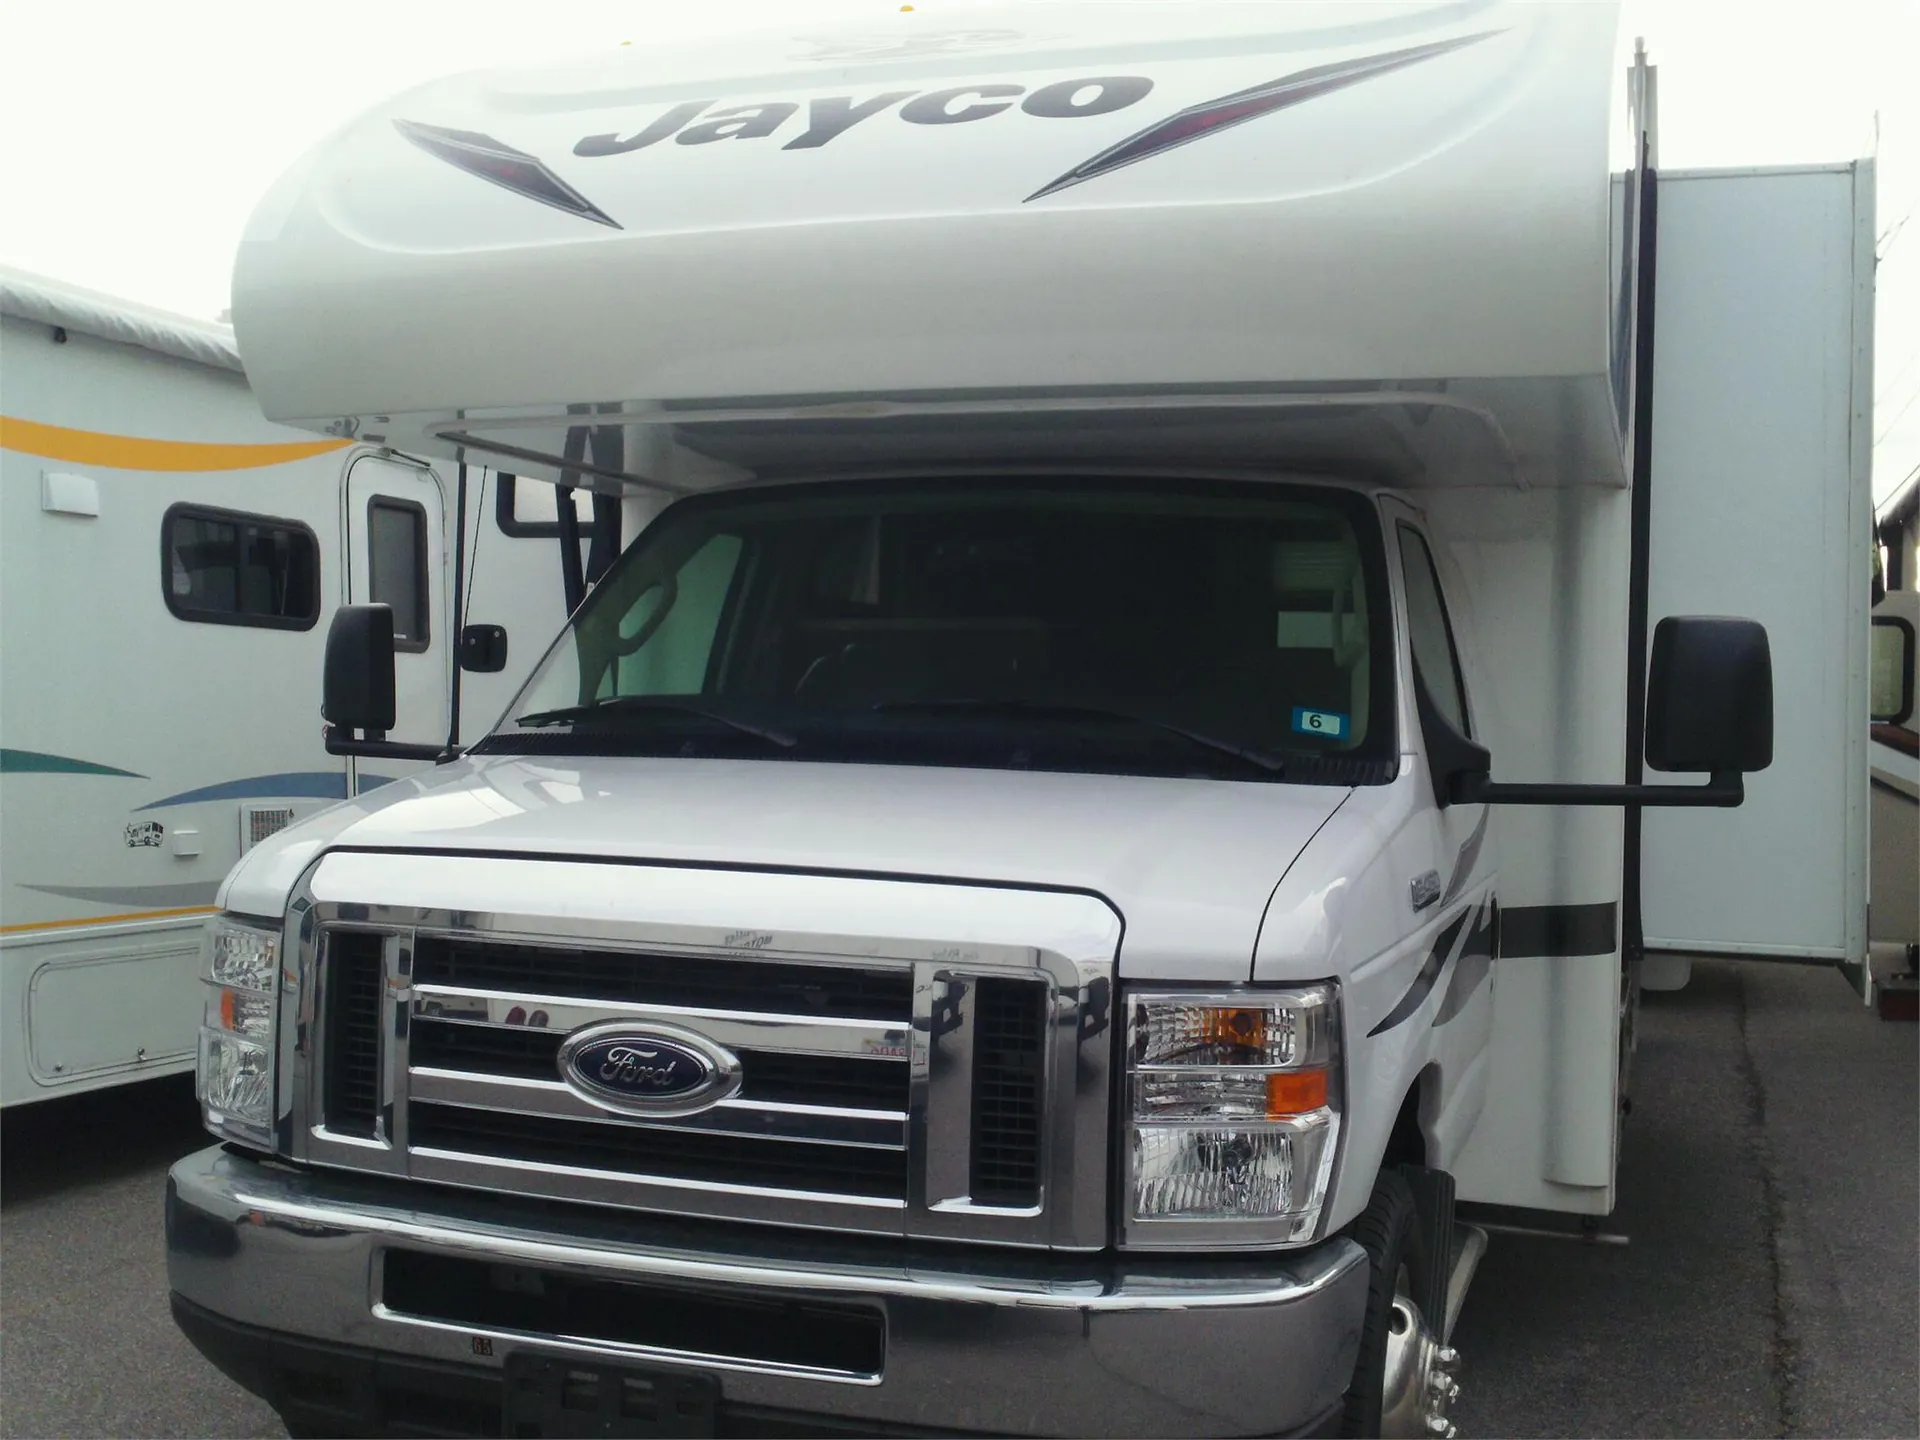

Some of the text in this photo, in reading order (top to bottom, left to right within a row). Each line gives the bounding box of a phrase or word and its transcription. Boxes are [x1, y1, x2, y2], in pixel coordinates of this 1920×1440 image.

[573, 77, 1154, 157] Jayco
[1309, 714, 1322, 729] 6
[601, 1047, 677, 1086] Ford
